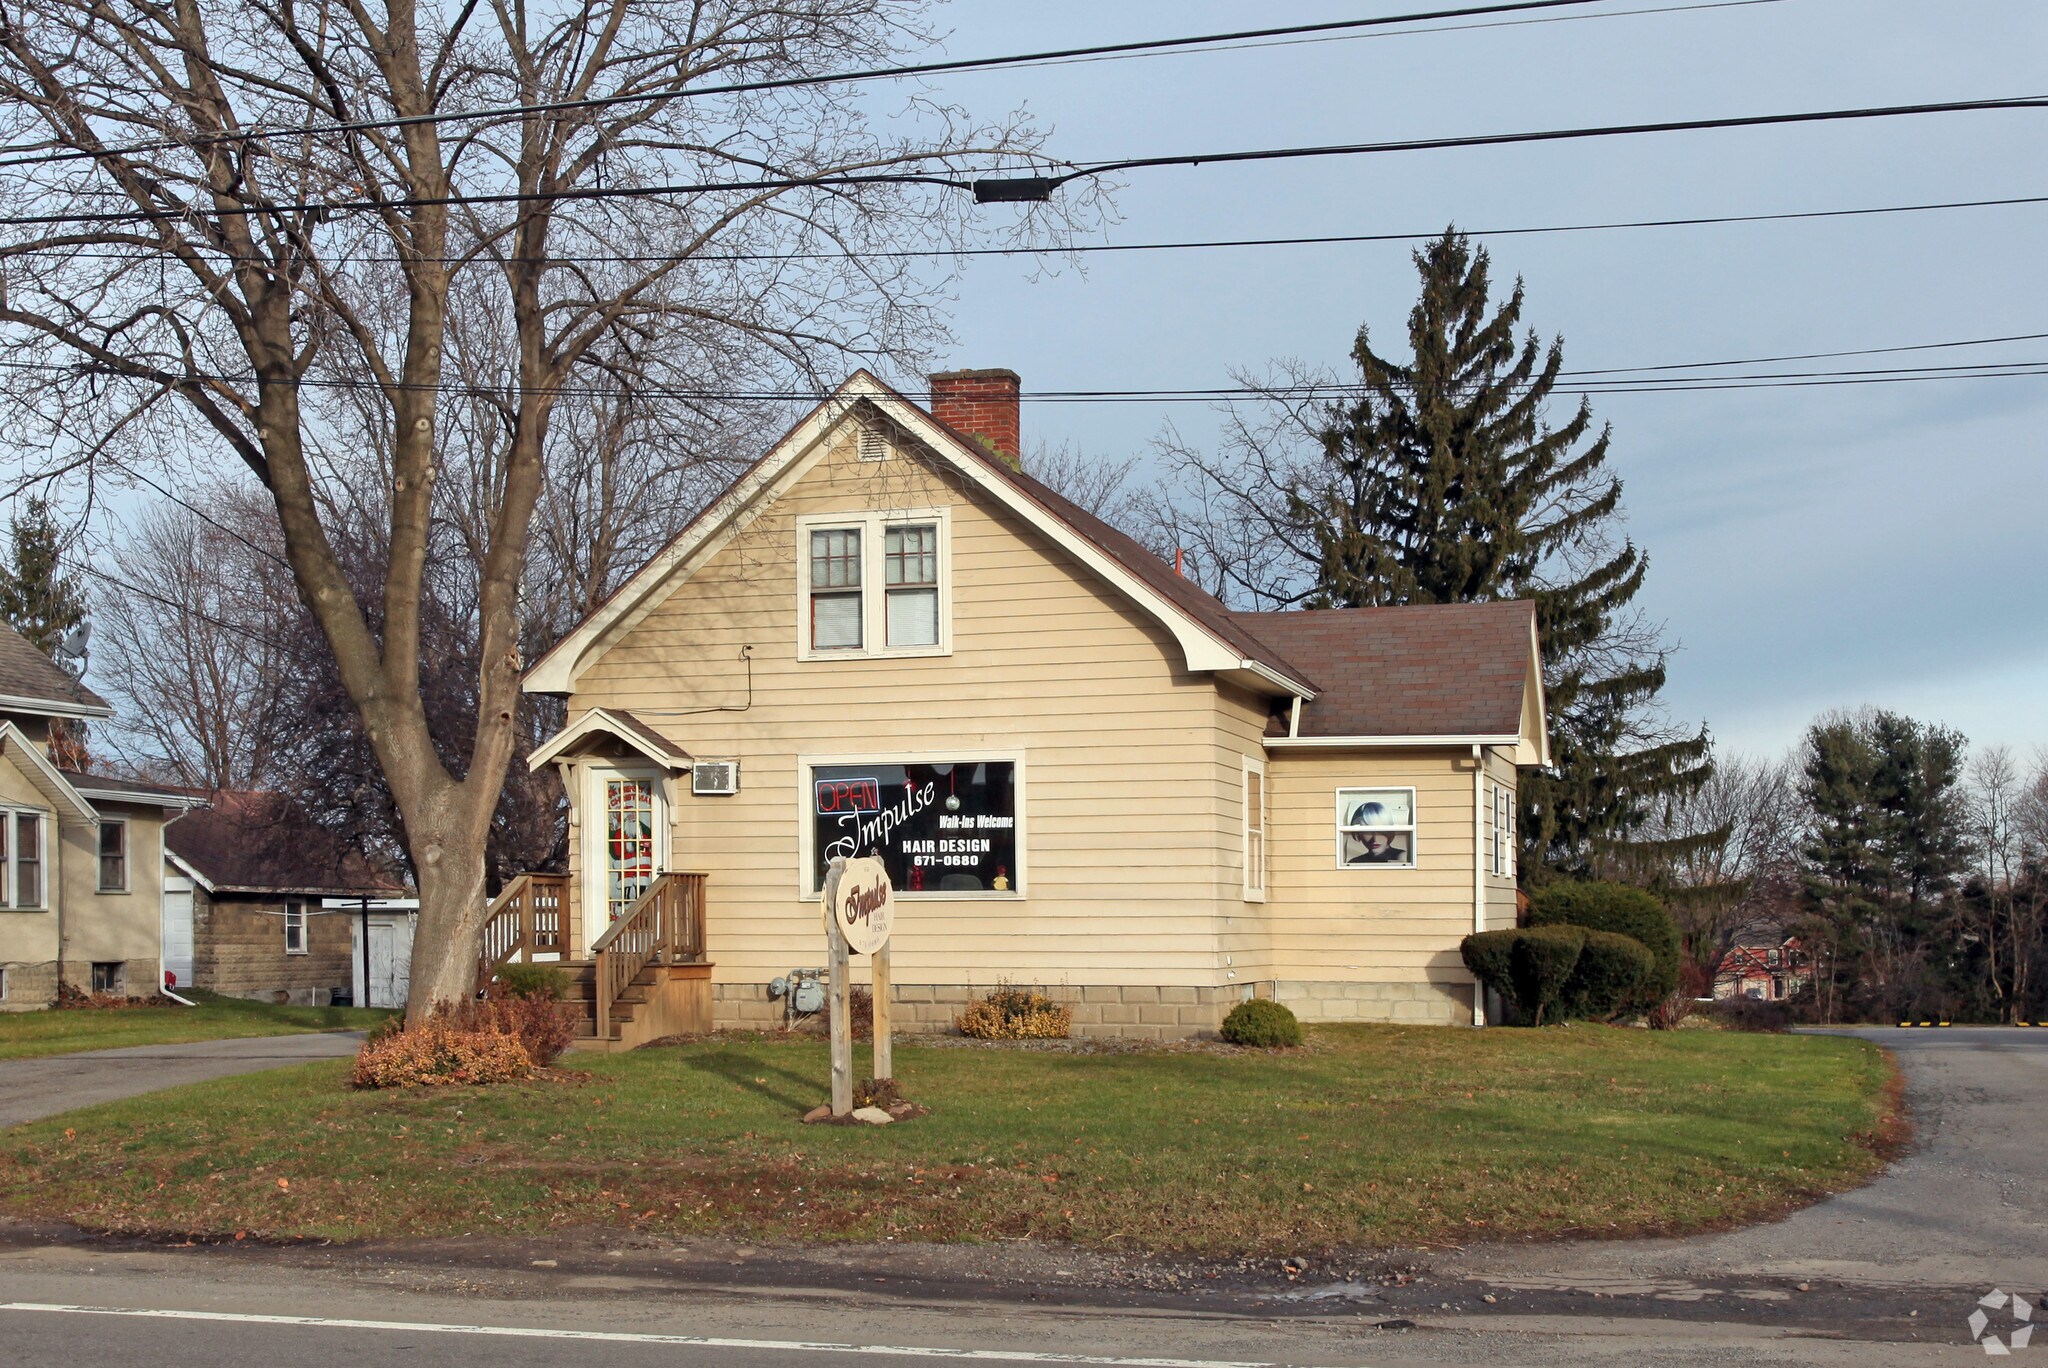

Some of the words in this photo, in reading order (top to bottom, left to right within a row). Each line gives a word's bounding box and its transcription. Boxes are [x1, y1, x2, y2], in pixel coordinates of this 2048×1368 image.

[818, 781, 877, 811] OPEN
[824, 781, 936, 865] Impulse
[939, 815, 975, 829] Walk-Ins
[976, 815, 1014, 828] Welcome
[903, 840, 936, 853] HAIR
[939, 839, 990, 853] DESIGN
[914, 855, 979, 866] 671-0680
